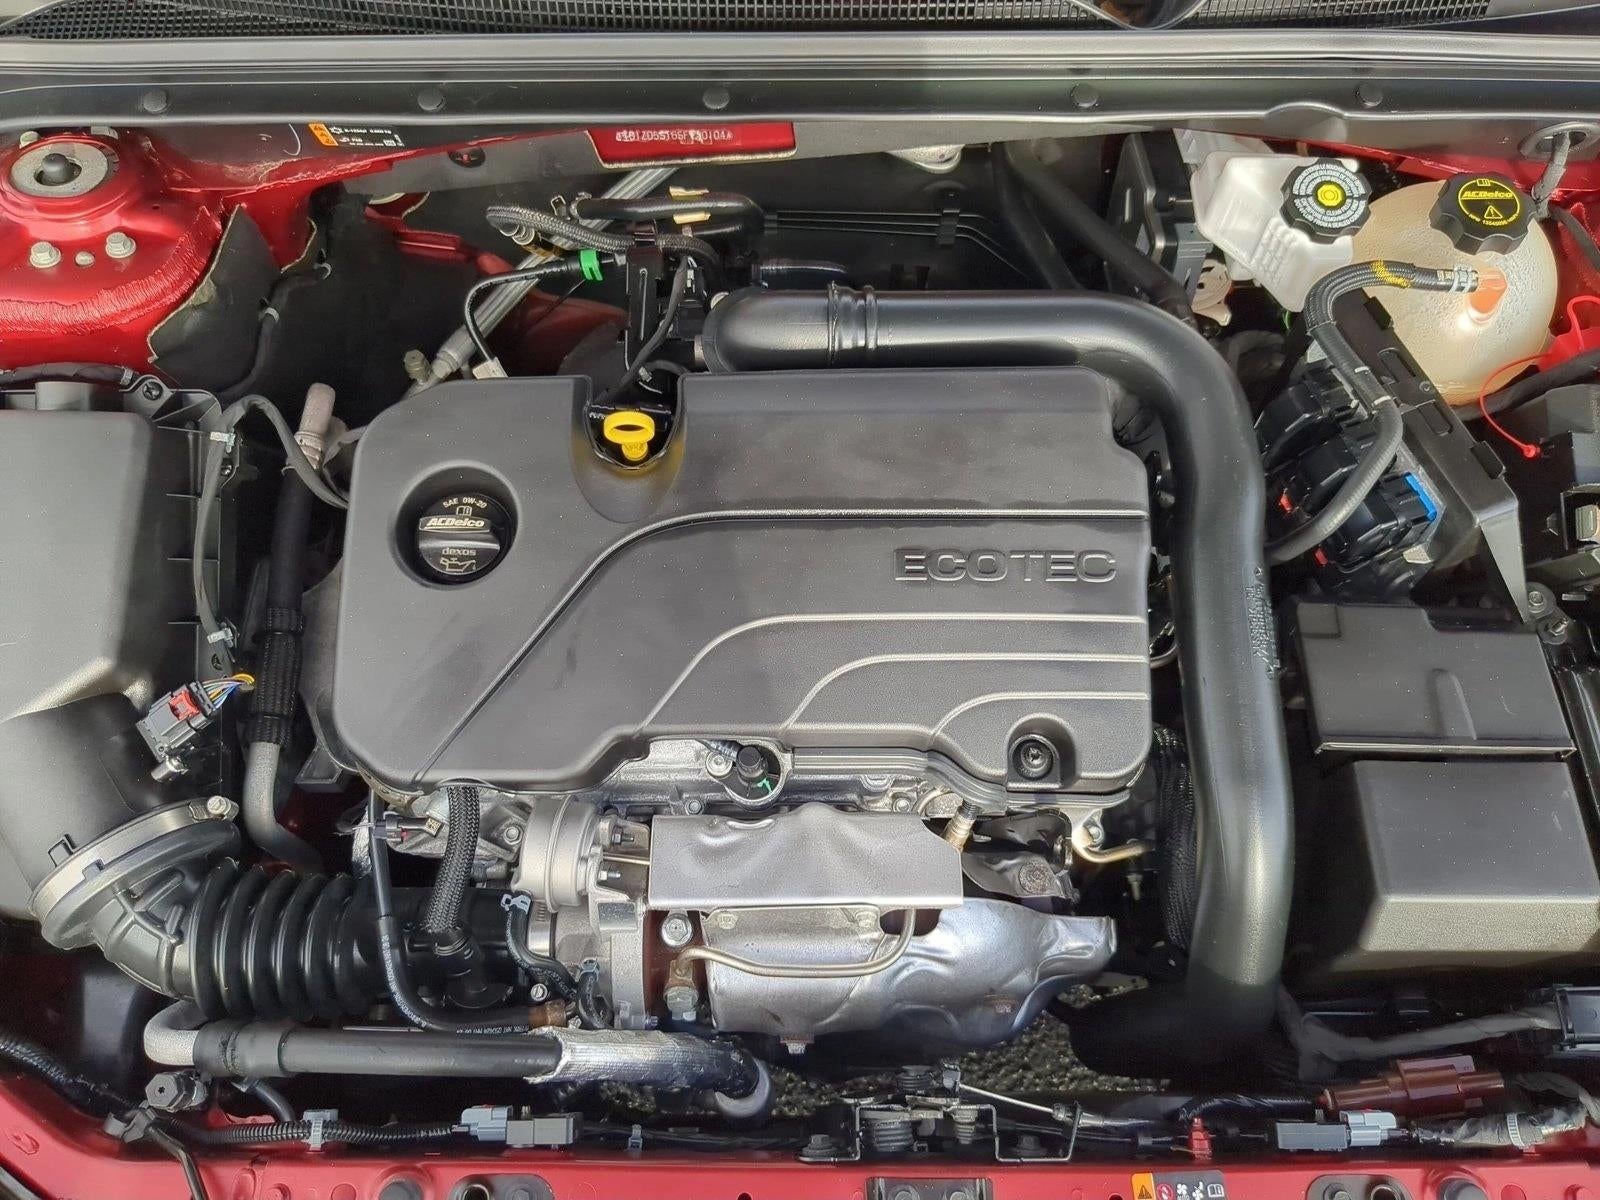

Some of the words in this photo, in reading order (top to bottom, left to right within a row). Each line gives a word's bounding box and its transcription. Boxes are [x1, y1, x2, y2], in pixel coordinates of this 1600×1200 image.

[442, 498, 459, 508] SAE
[462, 497, 487, 509] 0W-20
[426, 518, 485, 527] ACDelco
[442, 547, 476, 556] dexos
[893, 549, 1117, 583] ECOTEC
